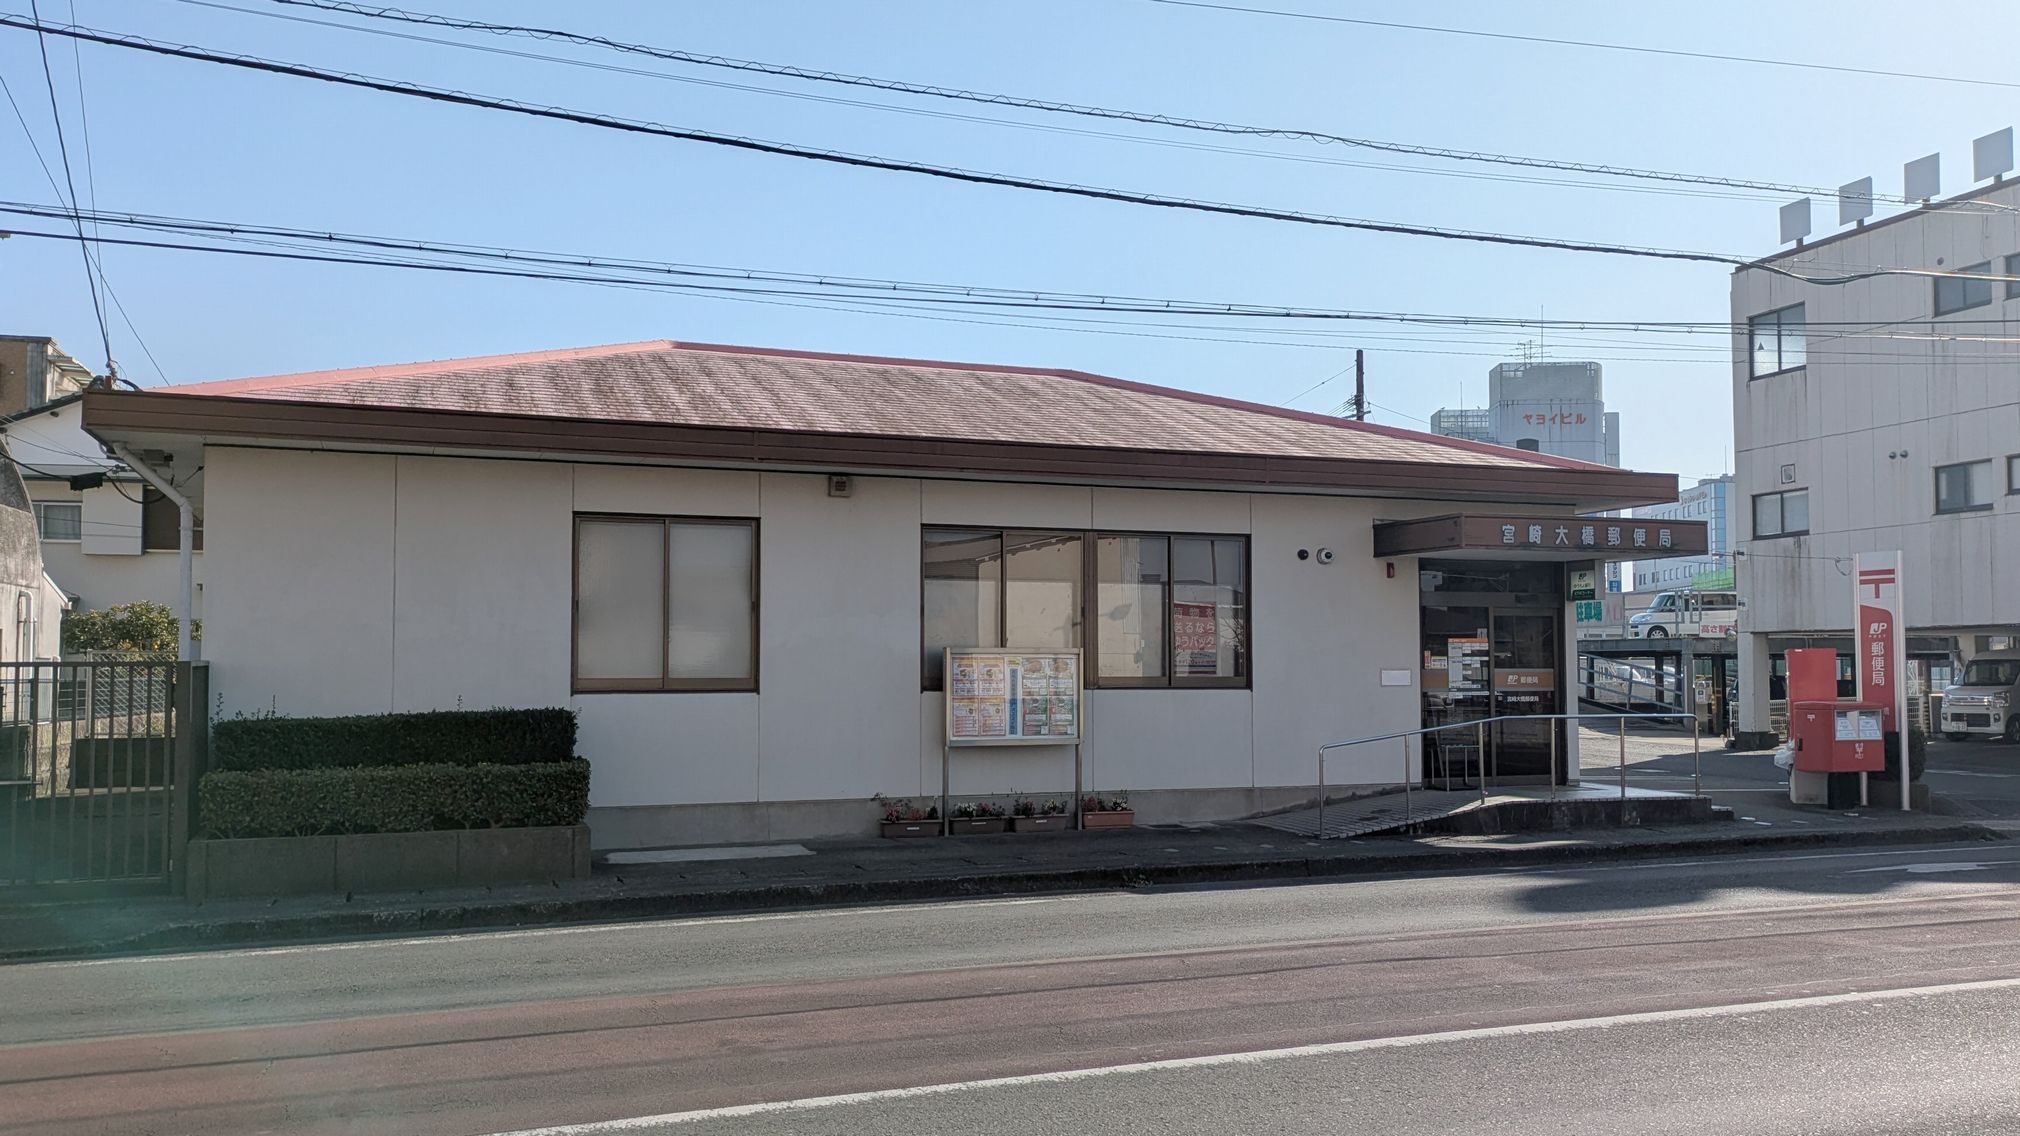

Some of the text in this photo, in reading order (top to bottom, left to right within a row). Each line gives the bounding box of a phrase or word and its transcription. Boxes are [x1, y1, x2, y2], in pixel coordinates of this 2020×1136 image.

[1522, 412, 1587, 425] ヤヨイビル
[1501, 523, 1672, 548] 宮崎大橋郵便局
[1871, 641, 1885, 686] 郵便局
